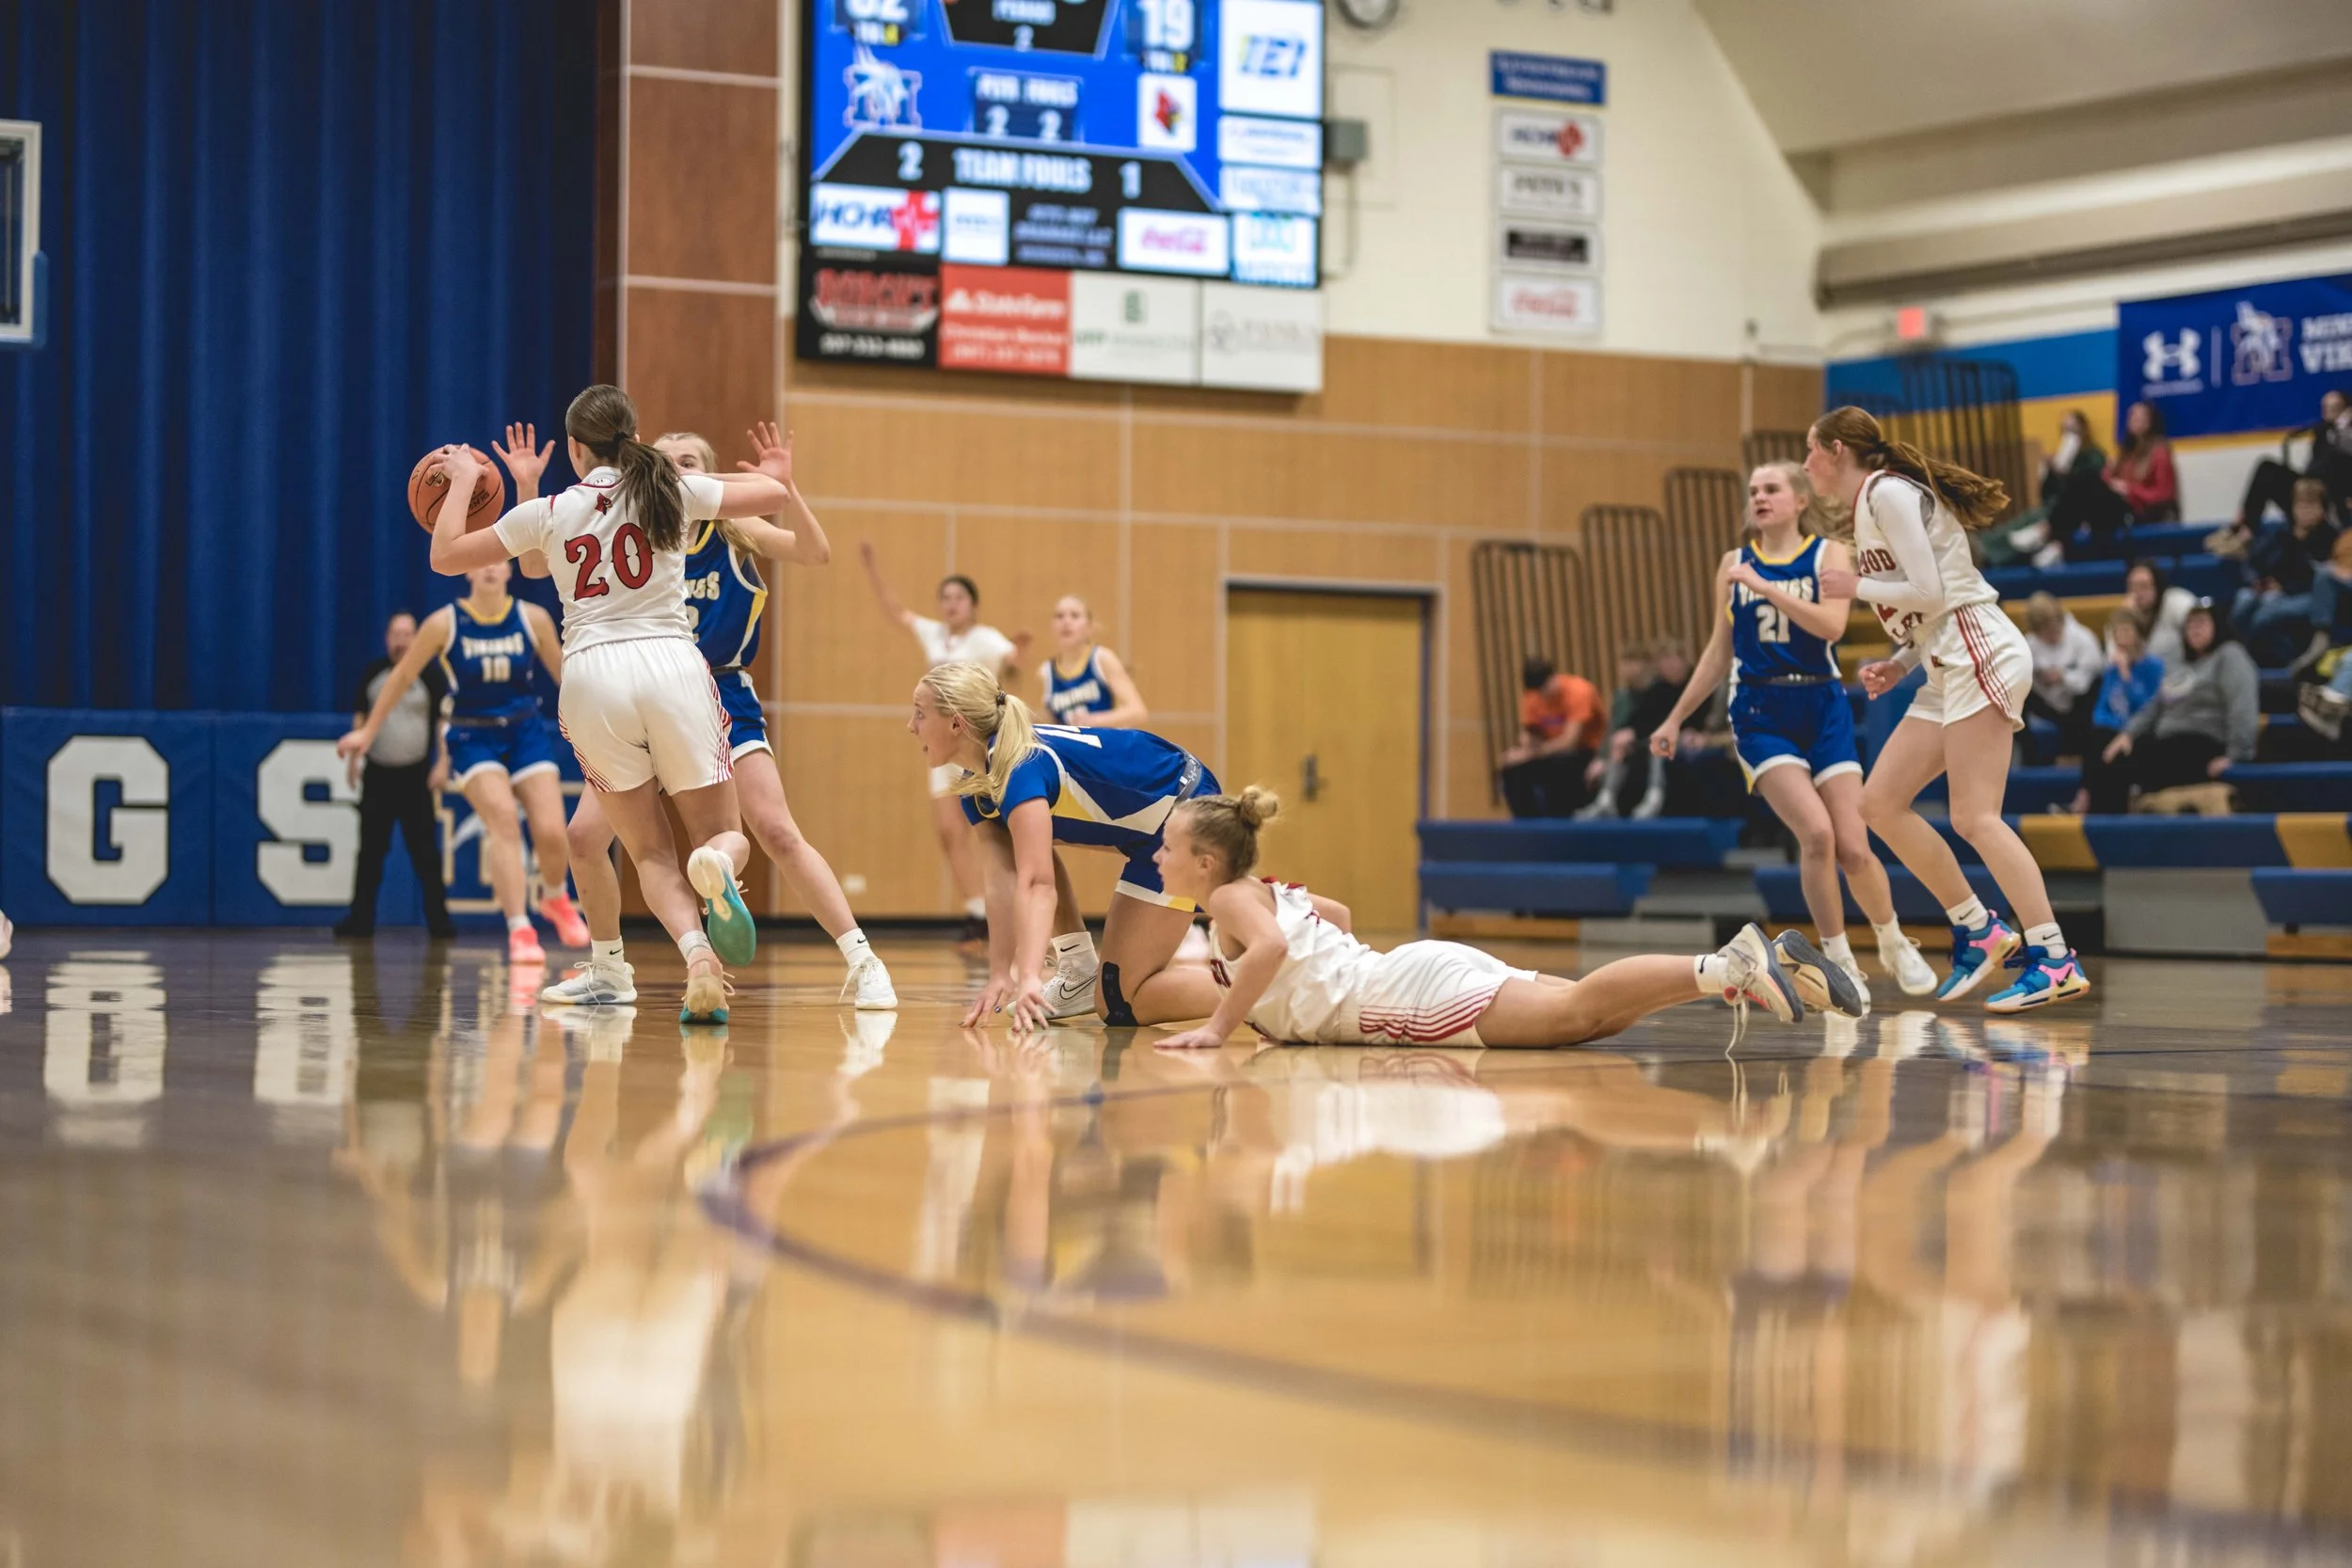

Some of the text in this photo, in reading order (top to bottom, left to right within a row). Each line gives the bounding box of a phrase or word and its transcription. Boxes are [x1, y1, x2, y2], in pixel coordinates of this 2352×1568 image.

[985, 103, 1009, 138] 2
[1038, 109, 1063, 143] 2
[898, 140, 925, 181] 2
[1119, 161, 1141, 199] 1
[564, 522, 655, 601] 20
[1756, 604, 1791, 644] 21
